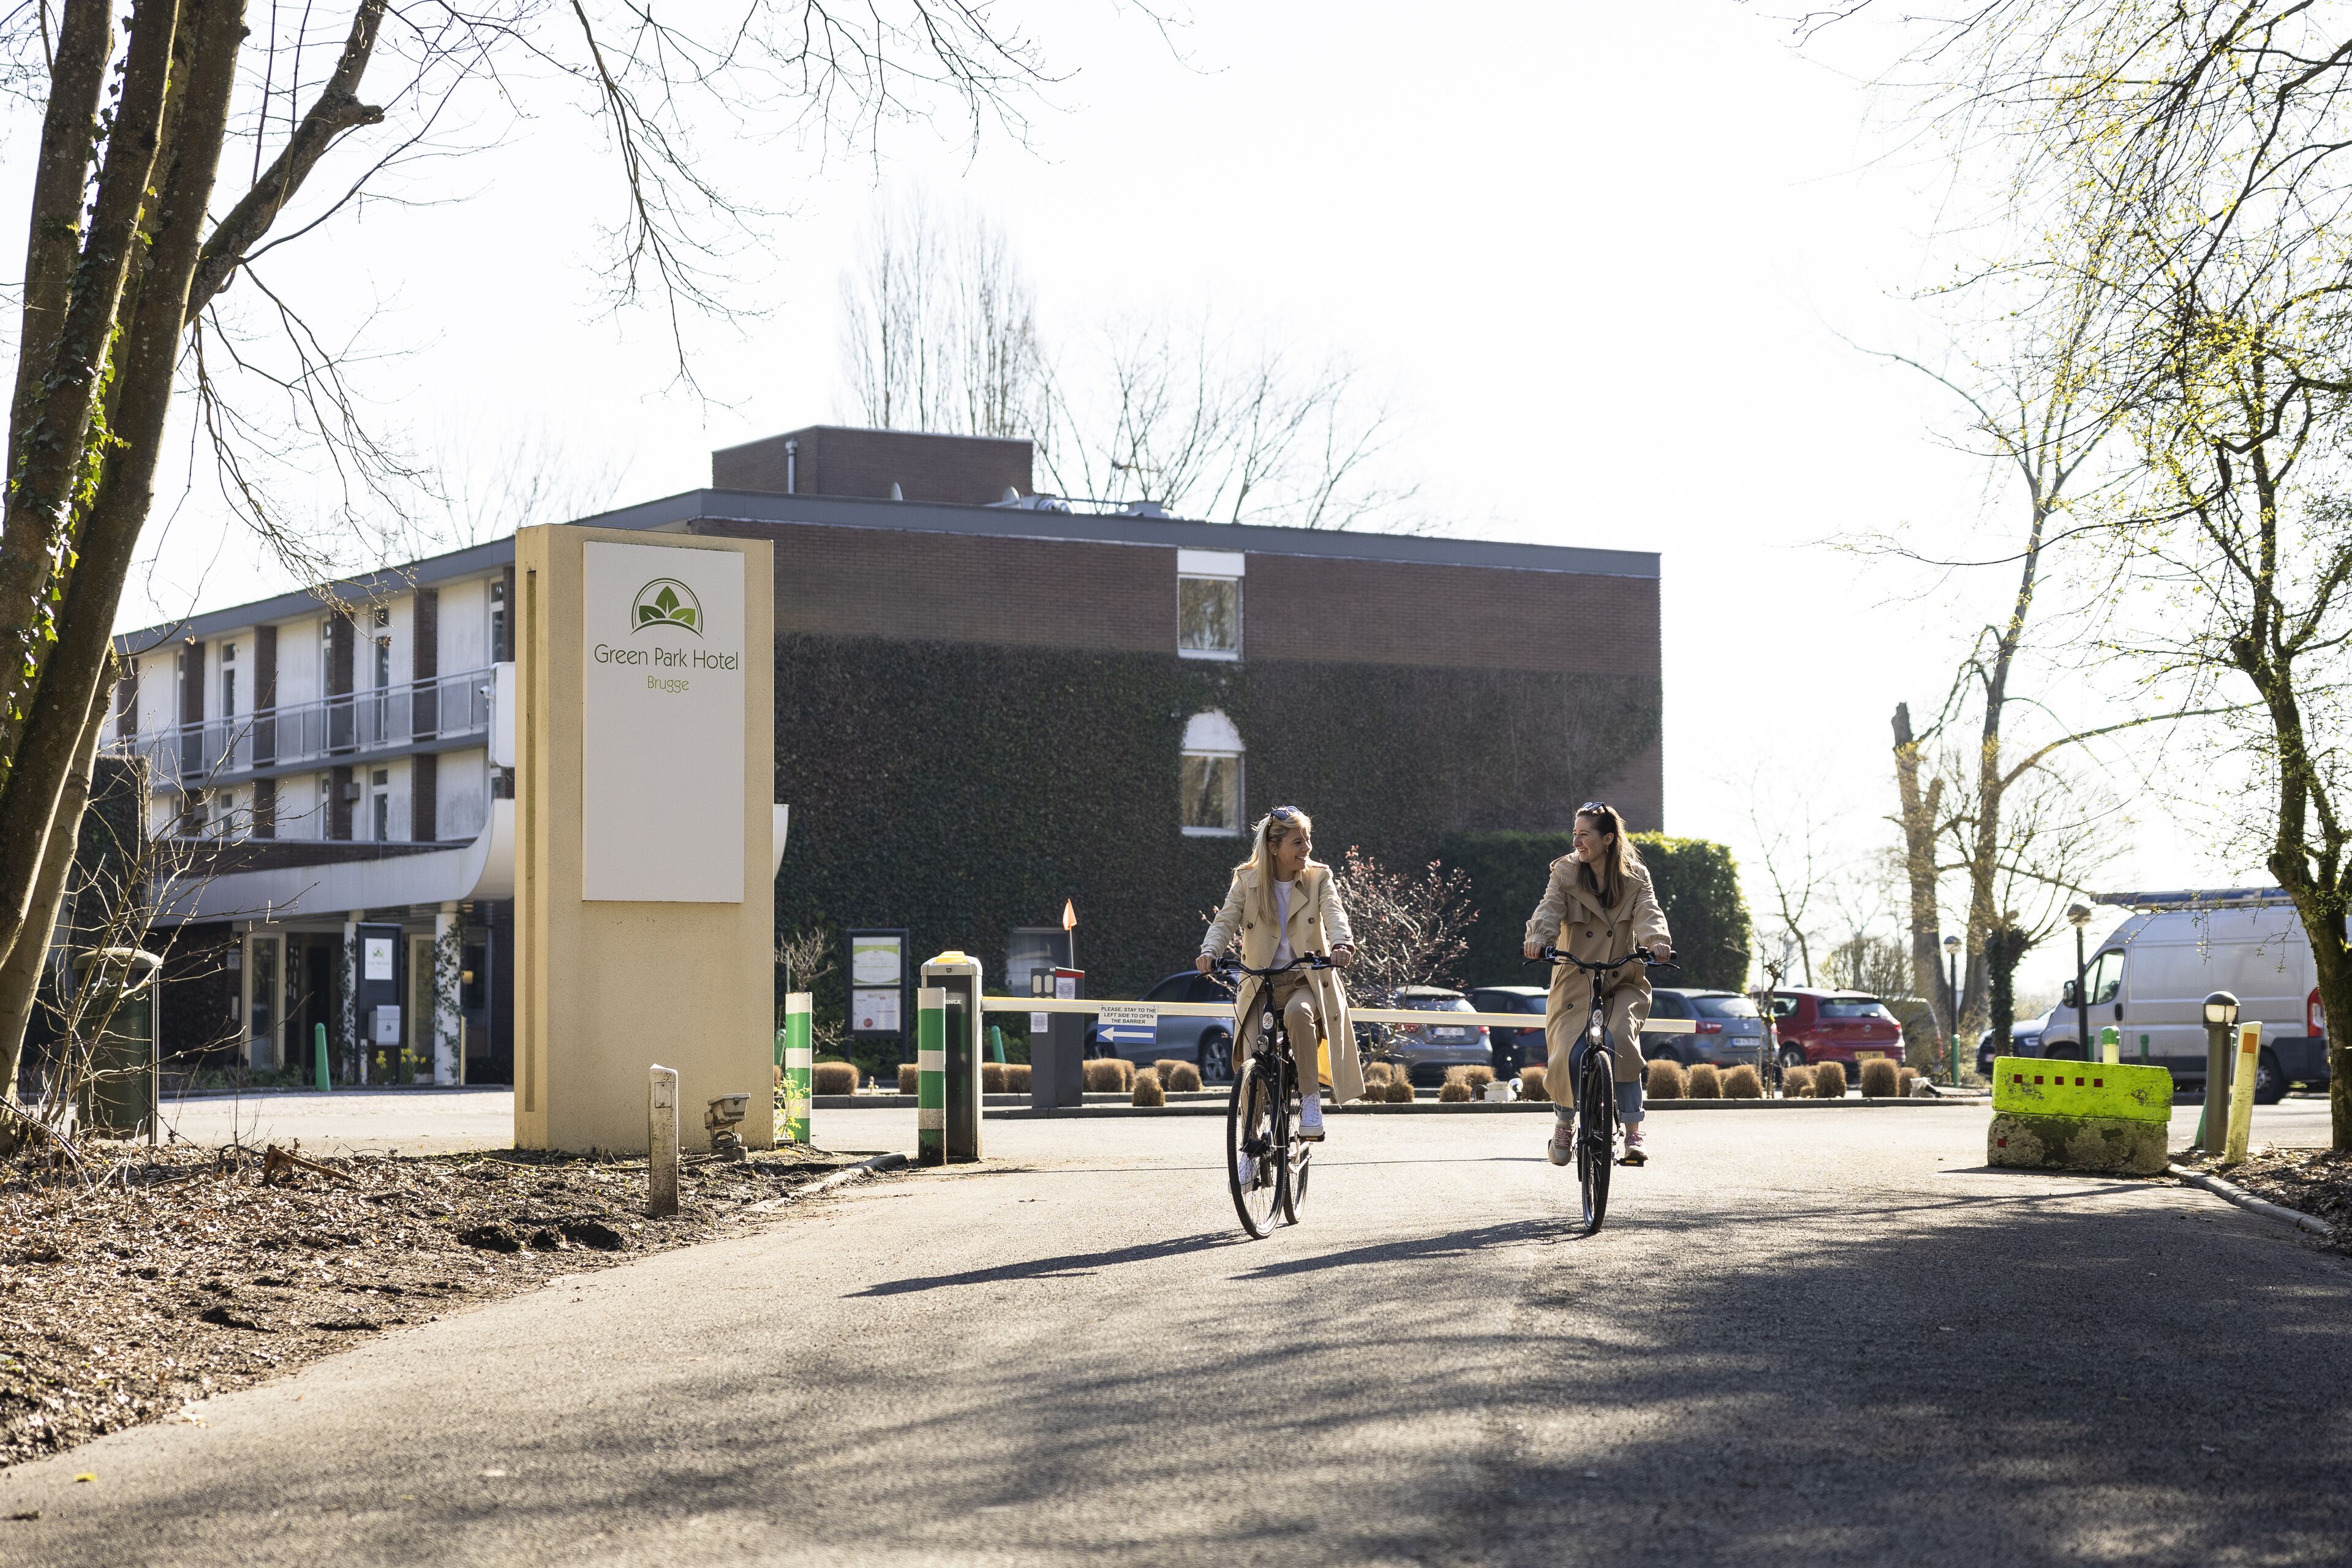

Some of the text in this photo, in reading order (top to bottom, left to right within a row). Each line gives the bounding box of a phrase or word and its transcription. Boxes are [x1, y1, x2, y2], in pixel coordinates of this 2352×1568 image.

[594, 644, 738, 670] Green Park Hotel
[647, 676, 689, 693] Brugge
